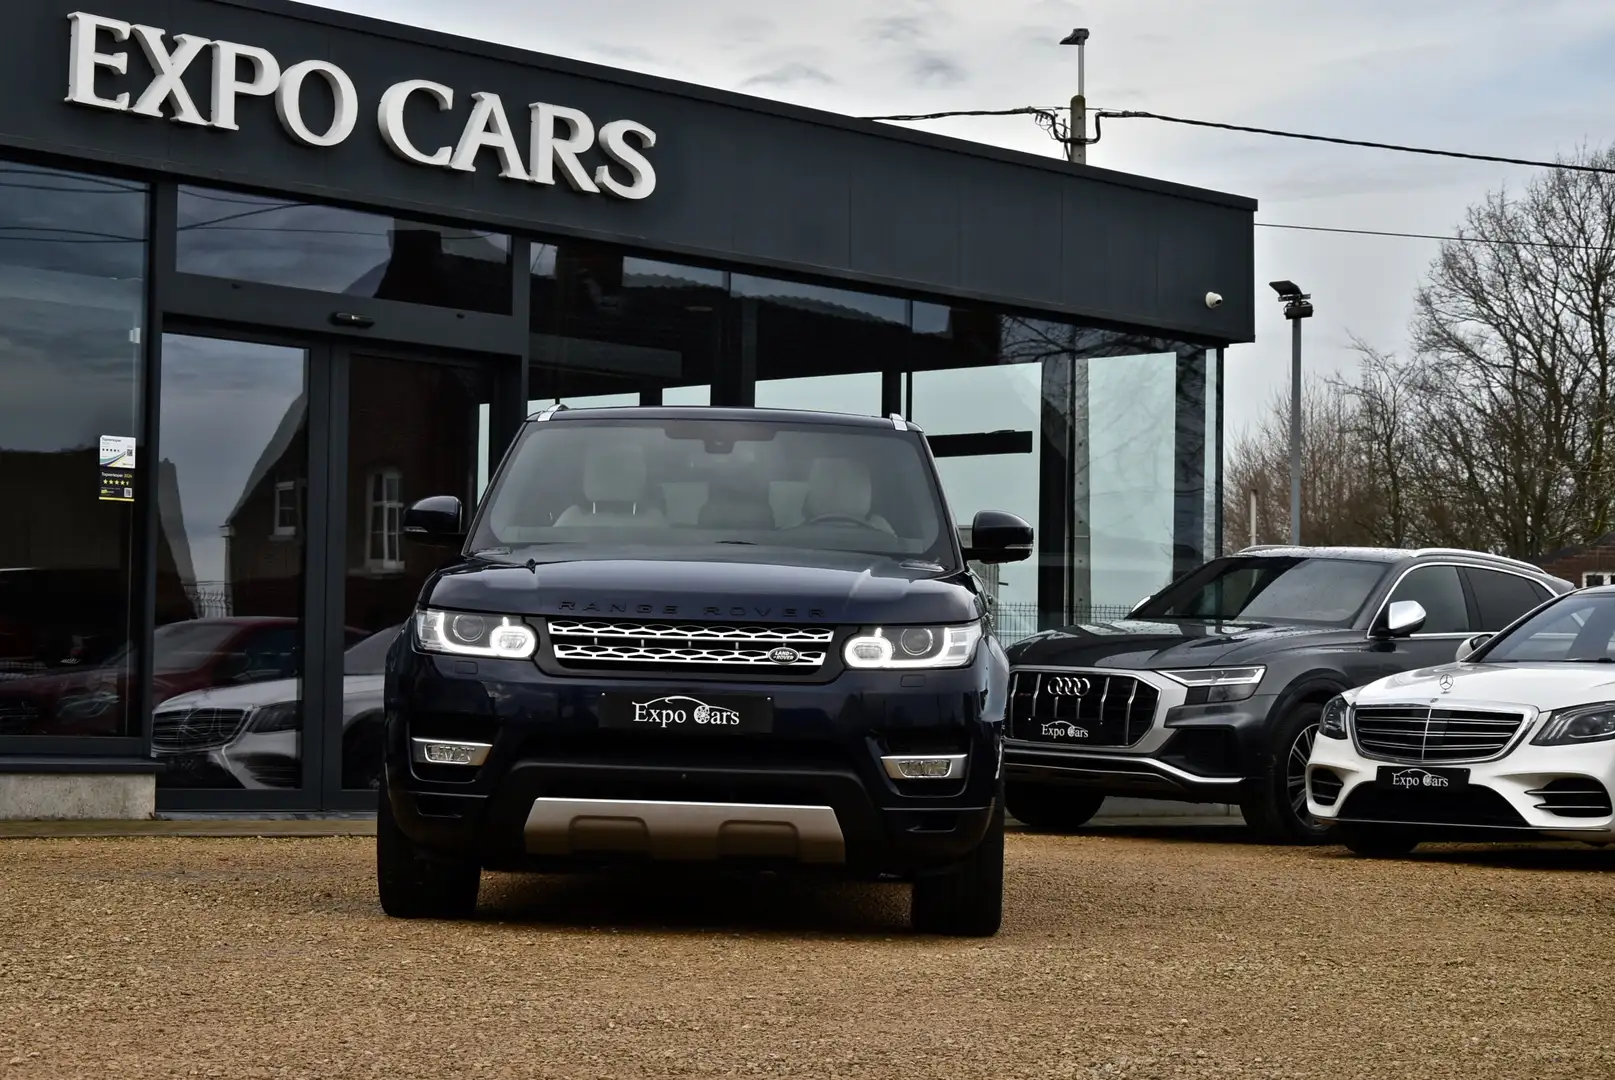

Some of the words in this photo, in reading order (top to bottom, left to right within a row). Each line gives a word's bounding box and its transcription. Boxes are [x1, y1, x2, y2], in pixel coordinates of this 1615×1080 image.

[64, 11, 358, 147] EXPO
[377, 79, 656, 200] CARS
[558, 601, 680, 614] RANGE
[703, 606, 825, 618] ROVER
[633, 704, 686, 728] Expo
[694, 704, 740, 726] Cars
[1042, 724, 1065, 739] Expo
[1067, 725, 1089, 738] Cars
[1392, 773, 1419, 788] Expo
[1422, 774, 1449, 787] Cars
